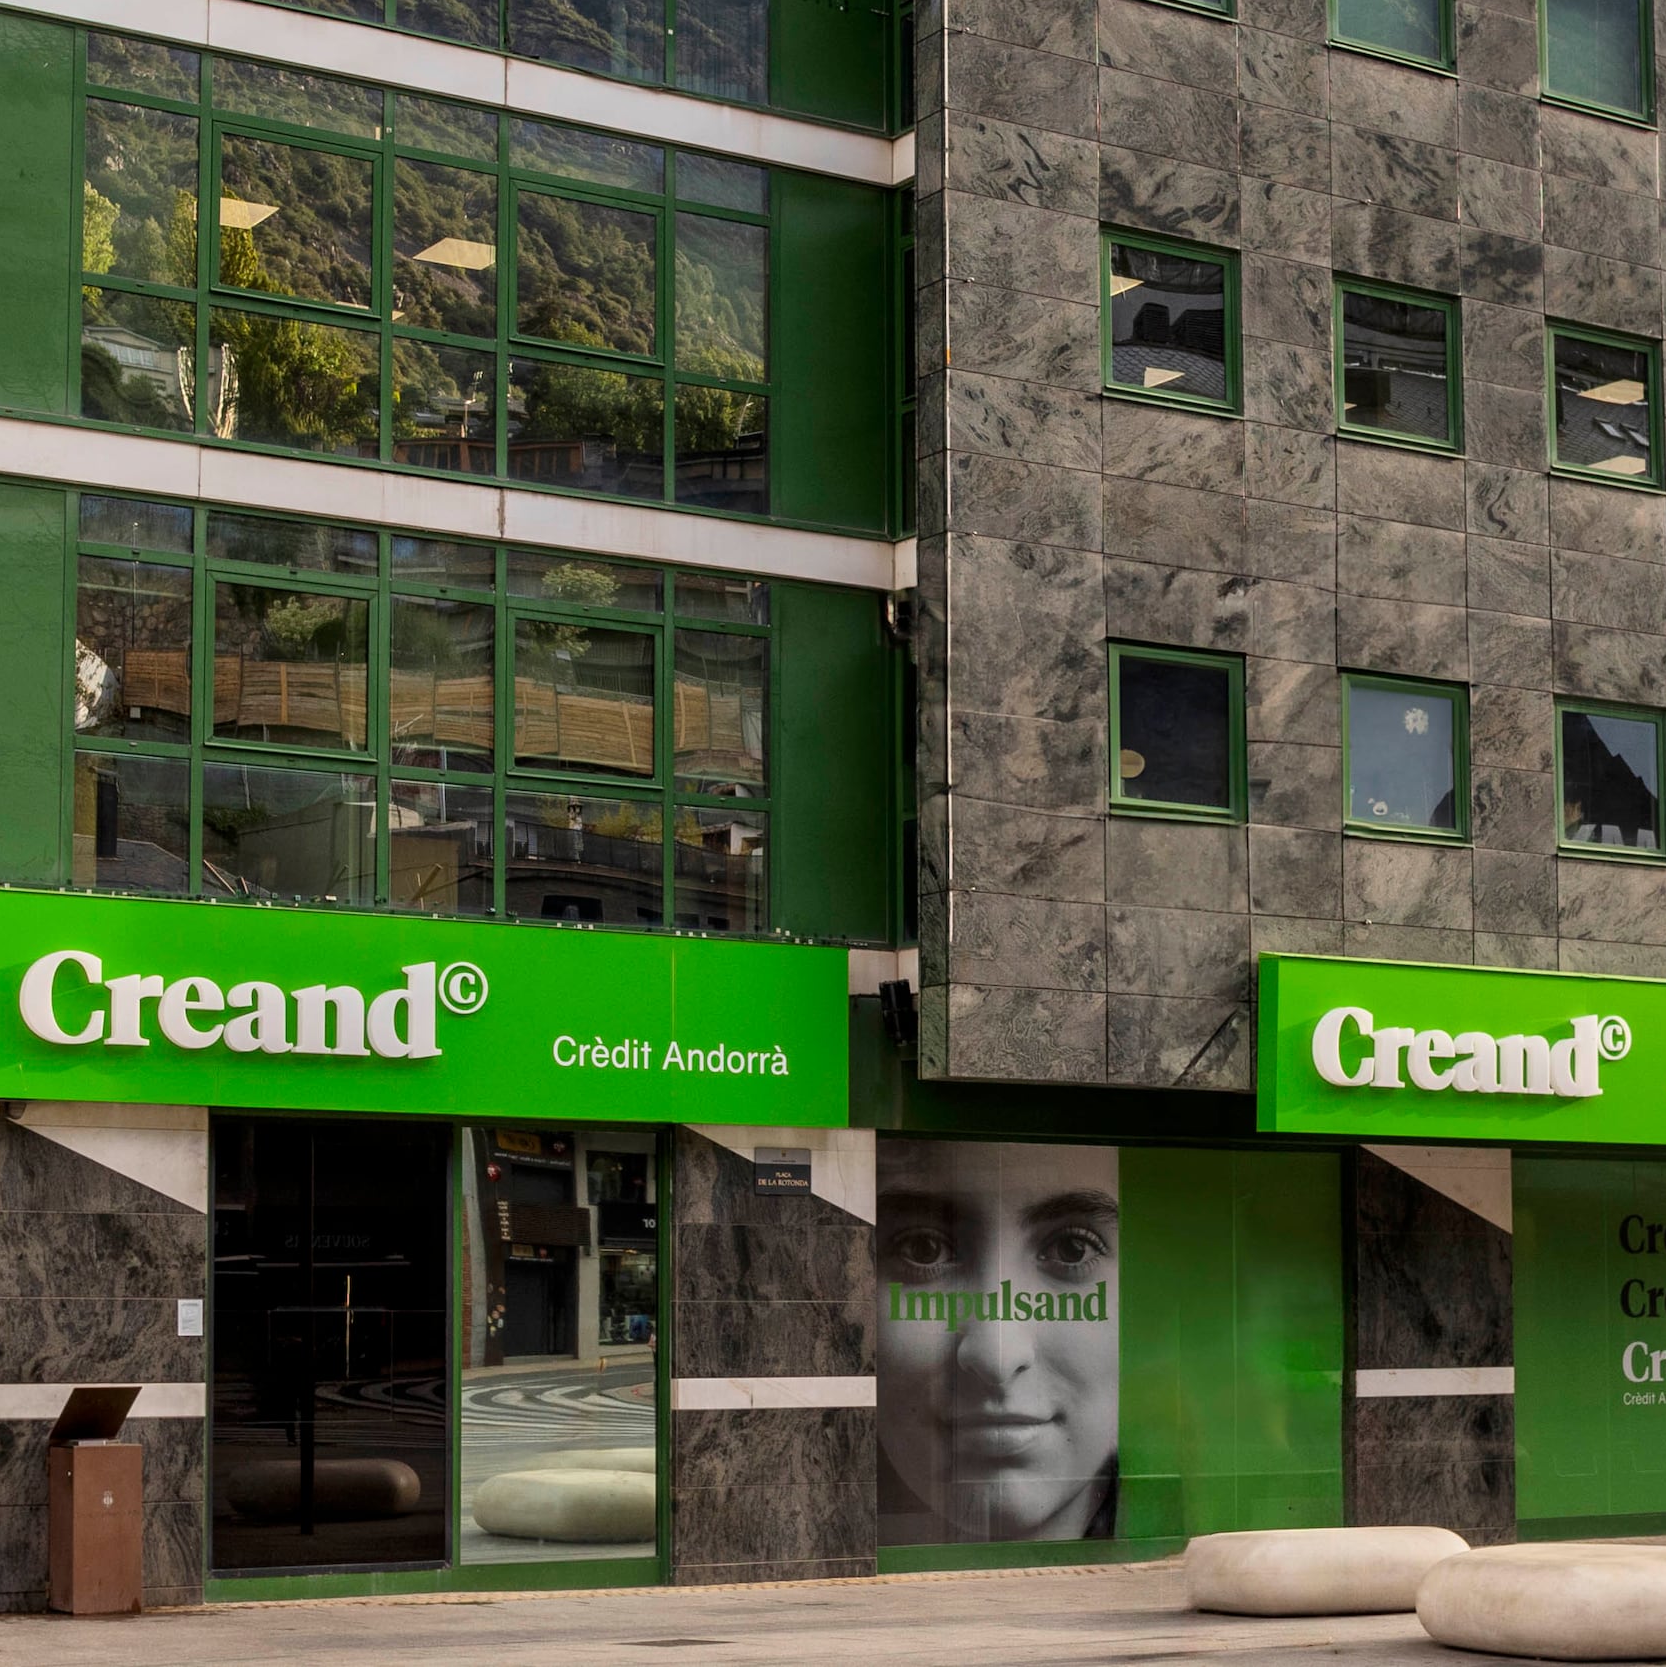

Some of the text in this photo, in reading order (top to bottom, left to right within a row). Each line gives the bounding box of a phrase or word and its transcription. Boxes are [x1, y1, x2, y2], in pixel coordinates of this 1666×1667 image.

[552, 1035, 790, 1076] Crèdit Andorrà
[757, 1178, 766, 1186] DE
[778, 1179, 809, 1187] ROTONDA
[888, 1280, 1109, 1332] Impulsand
[1623, 1392, 1655, 1405] Crèdit
